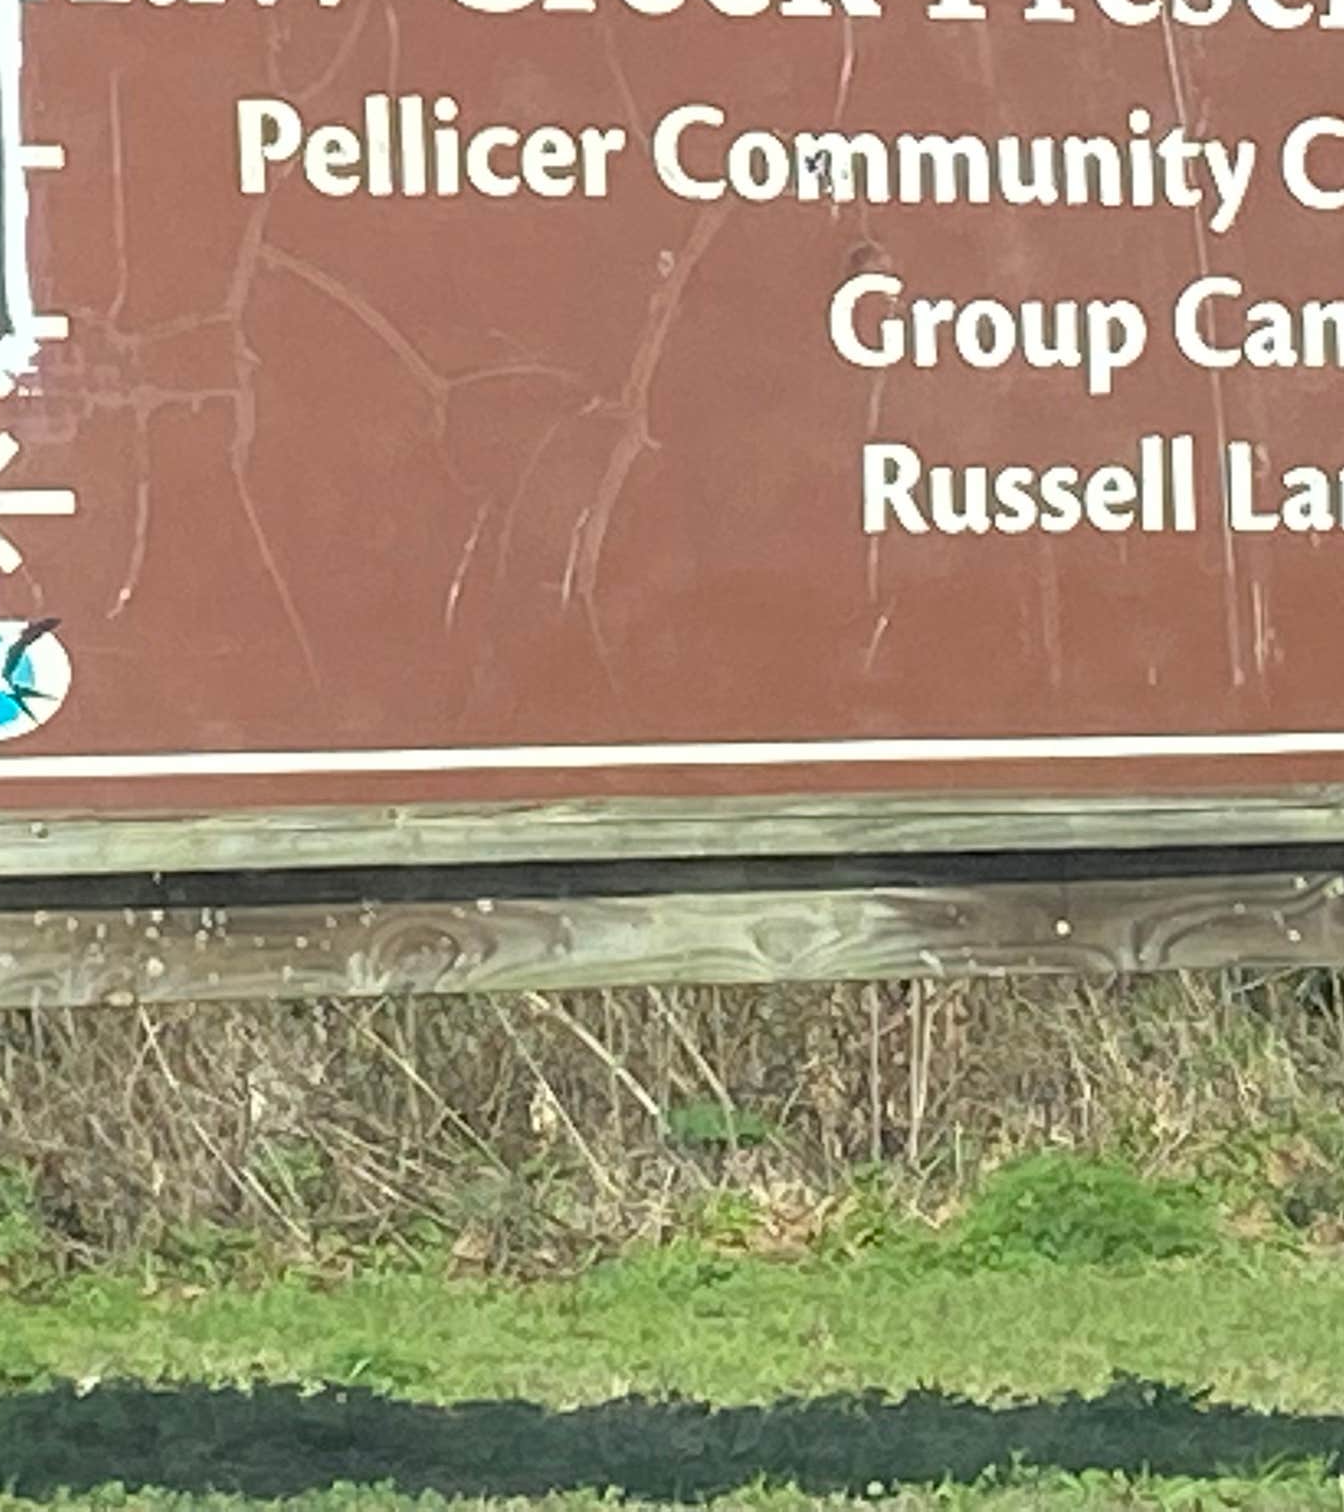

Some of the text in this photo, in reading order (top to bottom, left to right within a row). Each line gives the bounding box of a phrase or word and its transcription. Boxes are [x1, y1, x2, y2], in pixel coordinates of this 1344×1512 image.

[236, 93, 626, 198] Pellicer
[652, 104, 1257, 234] Community
[829, 272, 1148, 396] Group
[862, 433, 1197, 535] Russell
